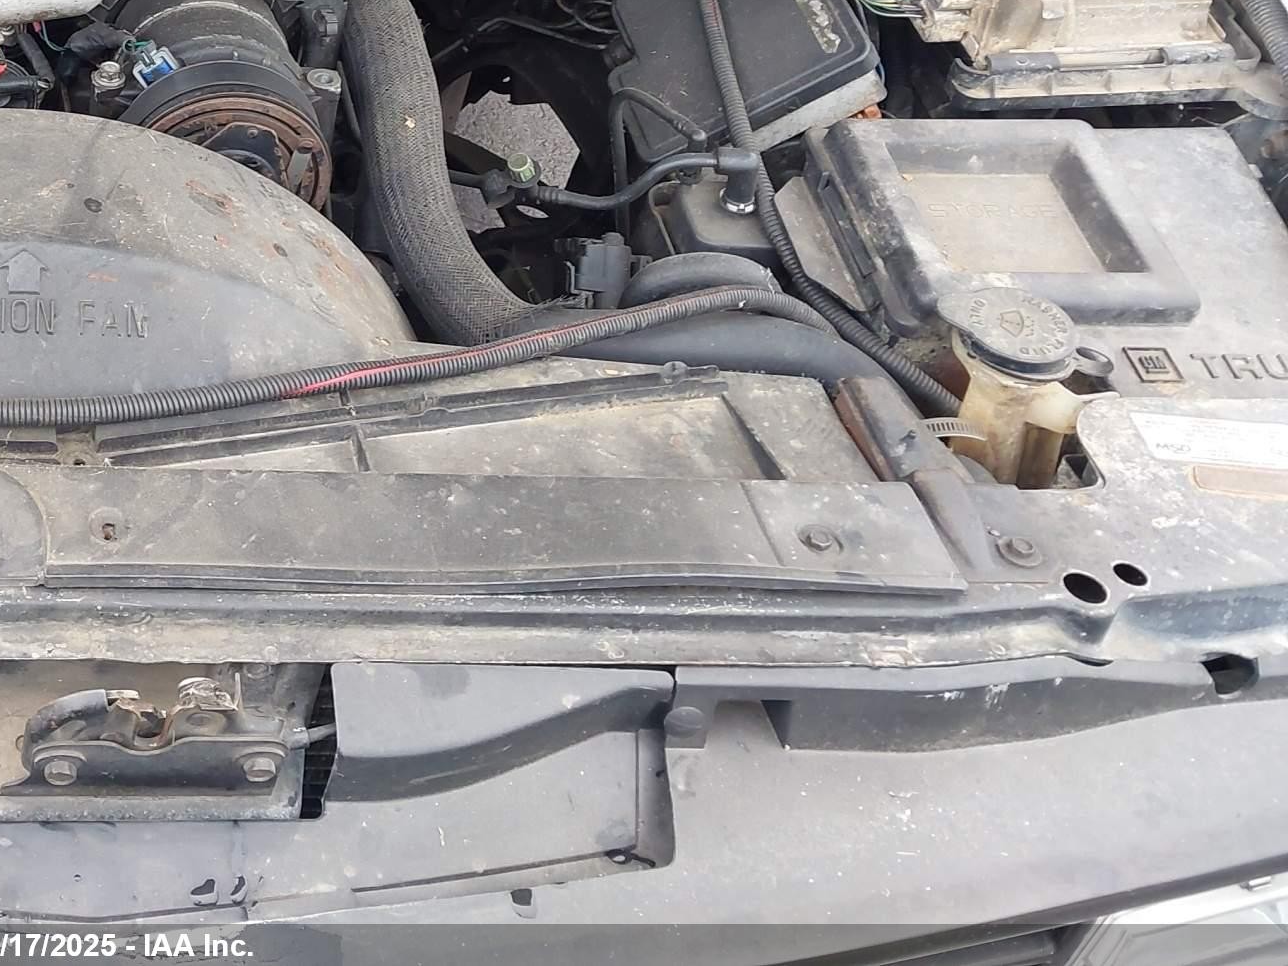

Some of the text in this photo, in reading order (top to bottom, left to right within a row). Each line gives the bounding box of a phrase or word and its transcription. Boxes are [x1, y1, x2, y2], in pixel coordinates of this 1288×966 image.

[927, 201, 1058, 219] STORAGE
[77, 298, 151, 339] FAN
[969, 297, 988, 327] ONLY
[1019, 337, 1066, 356] FLUID
